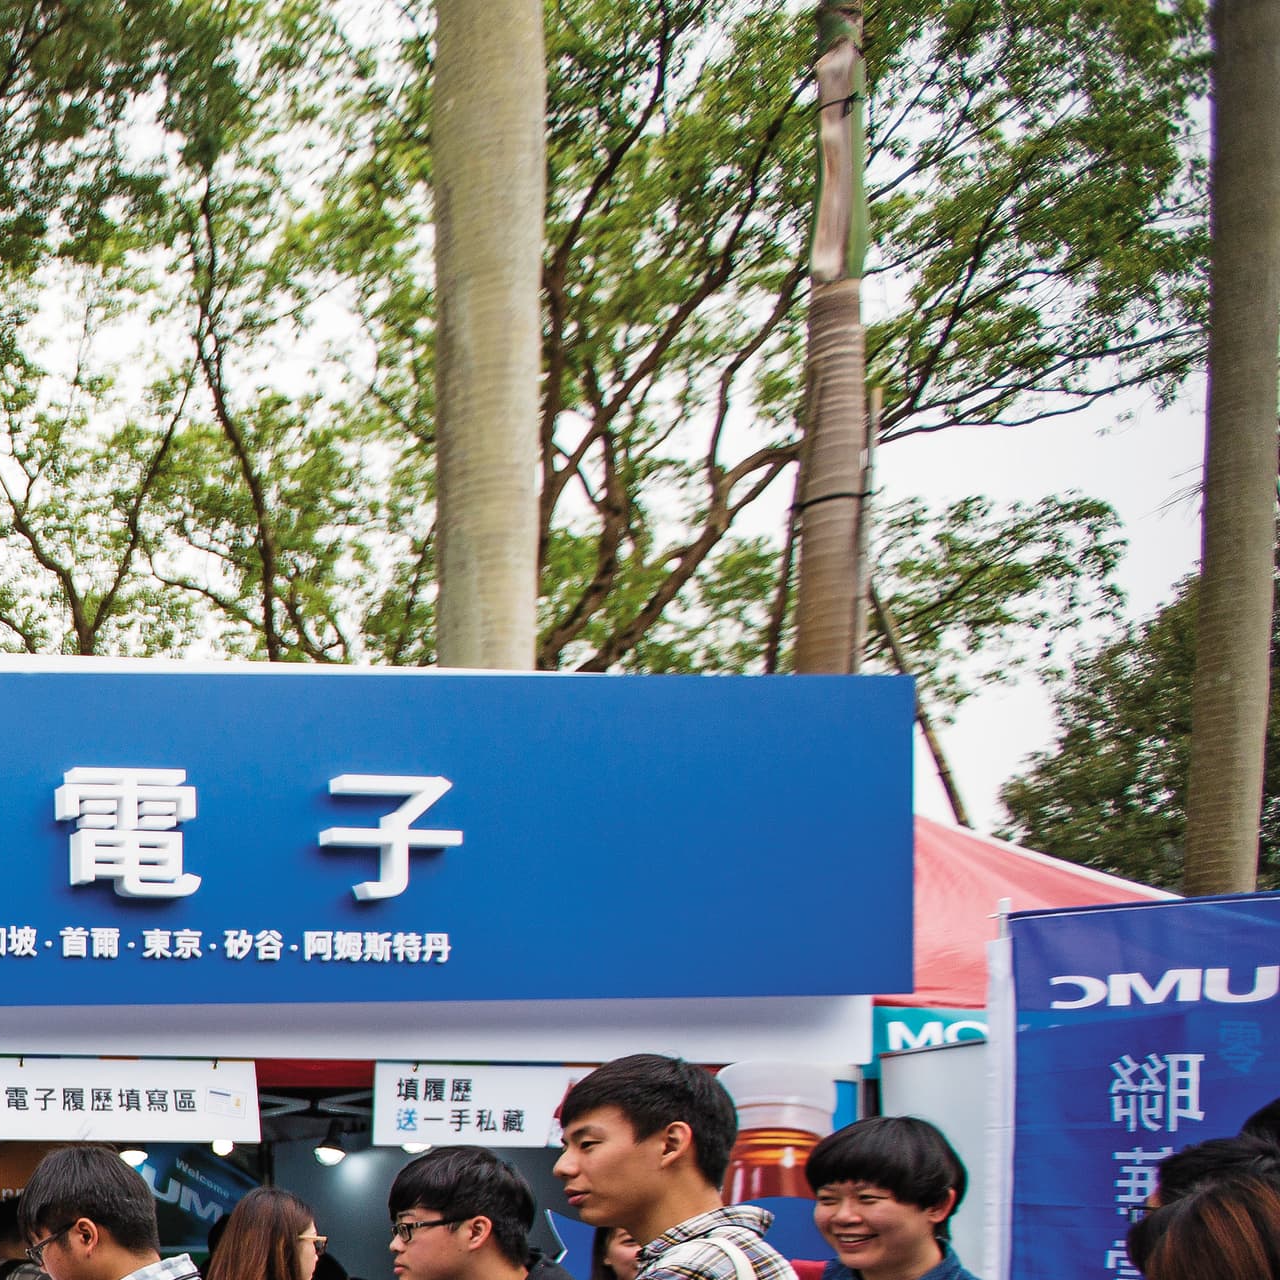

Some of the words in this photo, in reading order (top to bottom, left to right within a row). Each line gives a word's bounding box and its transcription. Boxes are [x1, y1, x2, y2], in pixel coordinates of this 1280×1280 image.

[5, 1086, 198, 1113] 電子履歷填寫區
[397, 1077, 473, 1102] 填履歷
[396, 1108, 525, 1133] 送一手私藏
[175, 1158, 230, 1199] Welcome
